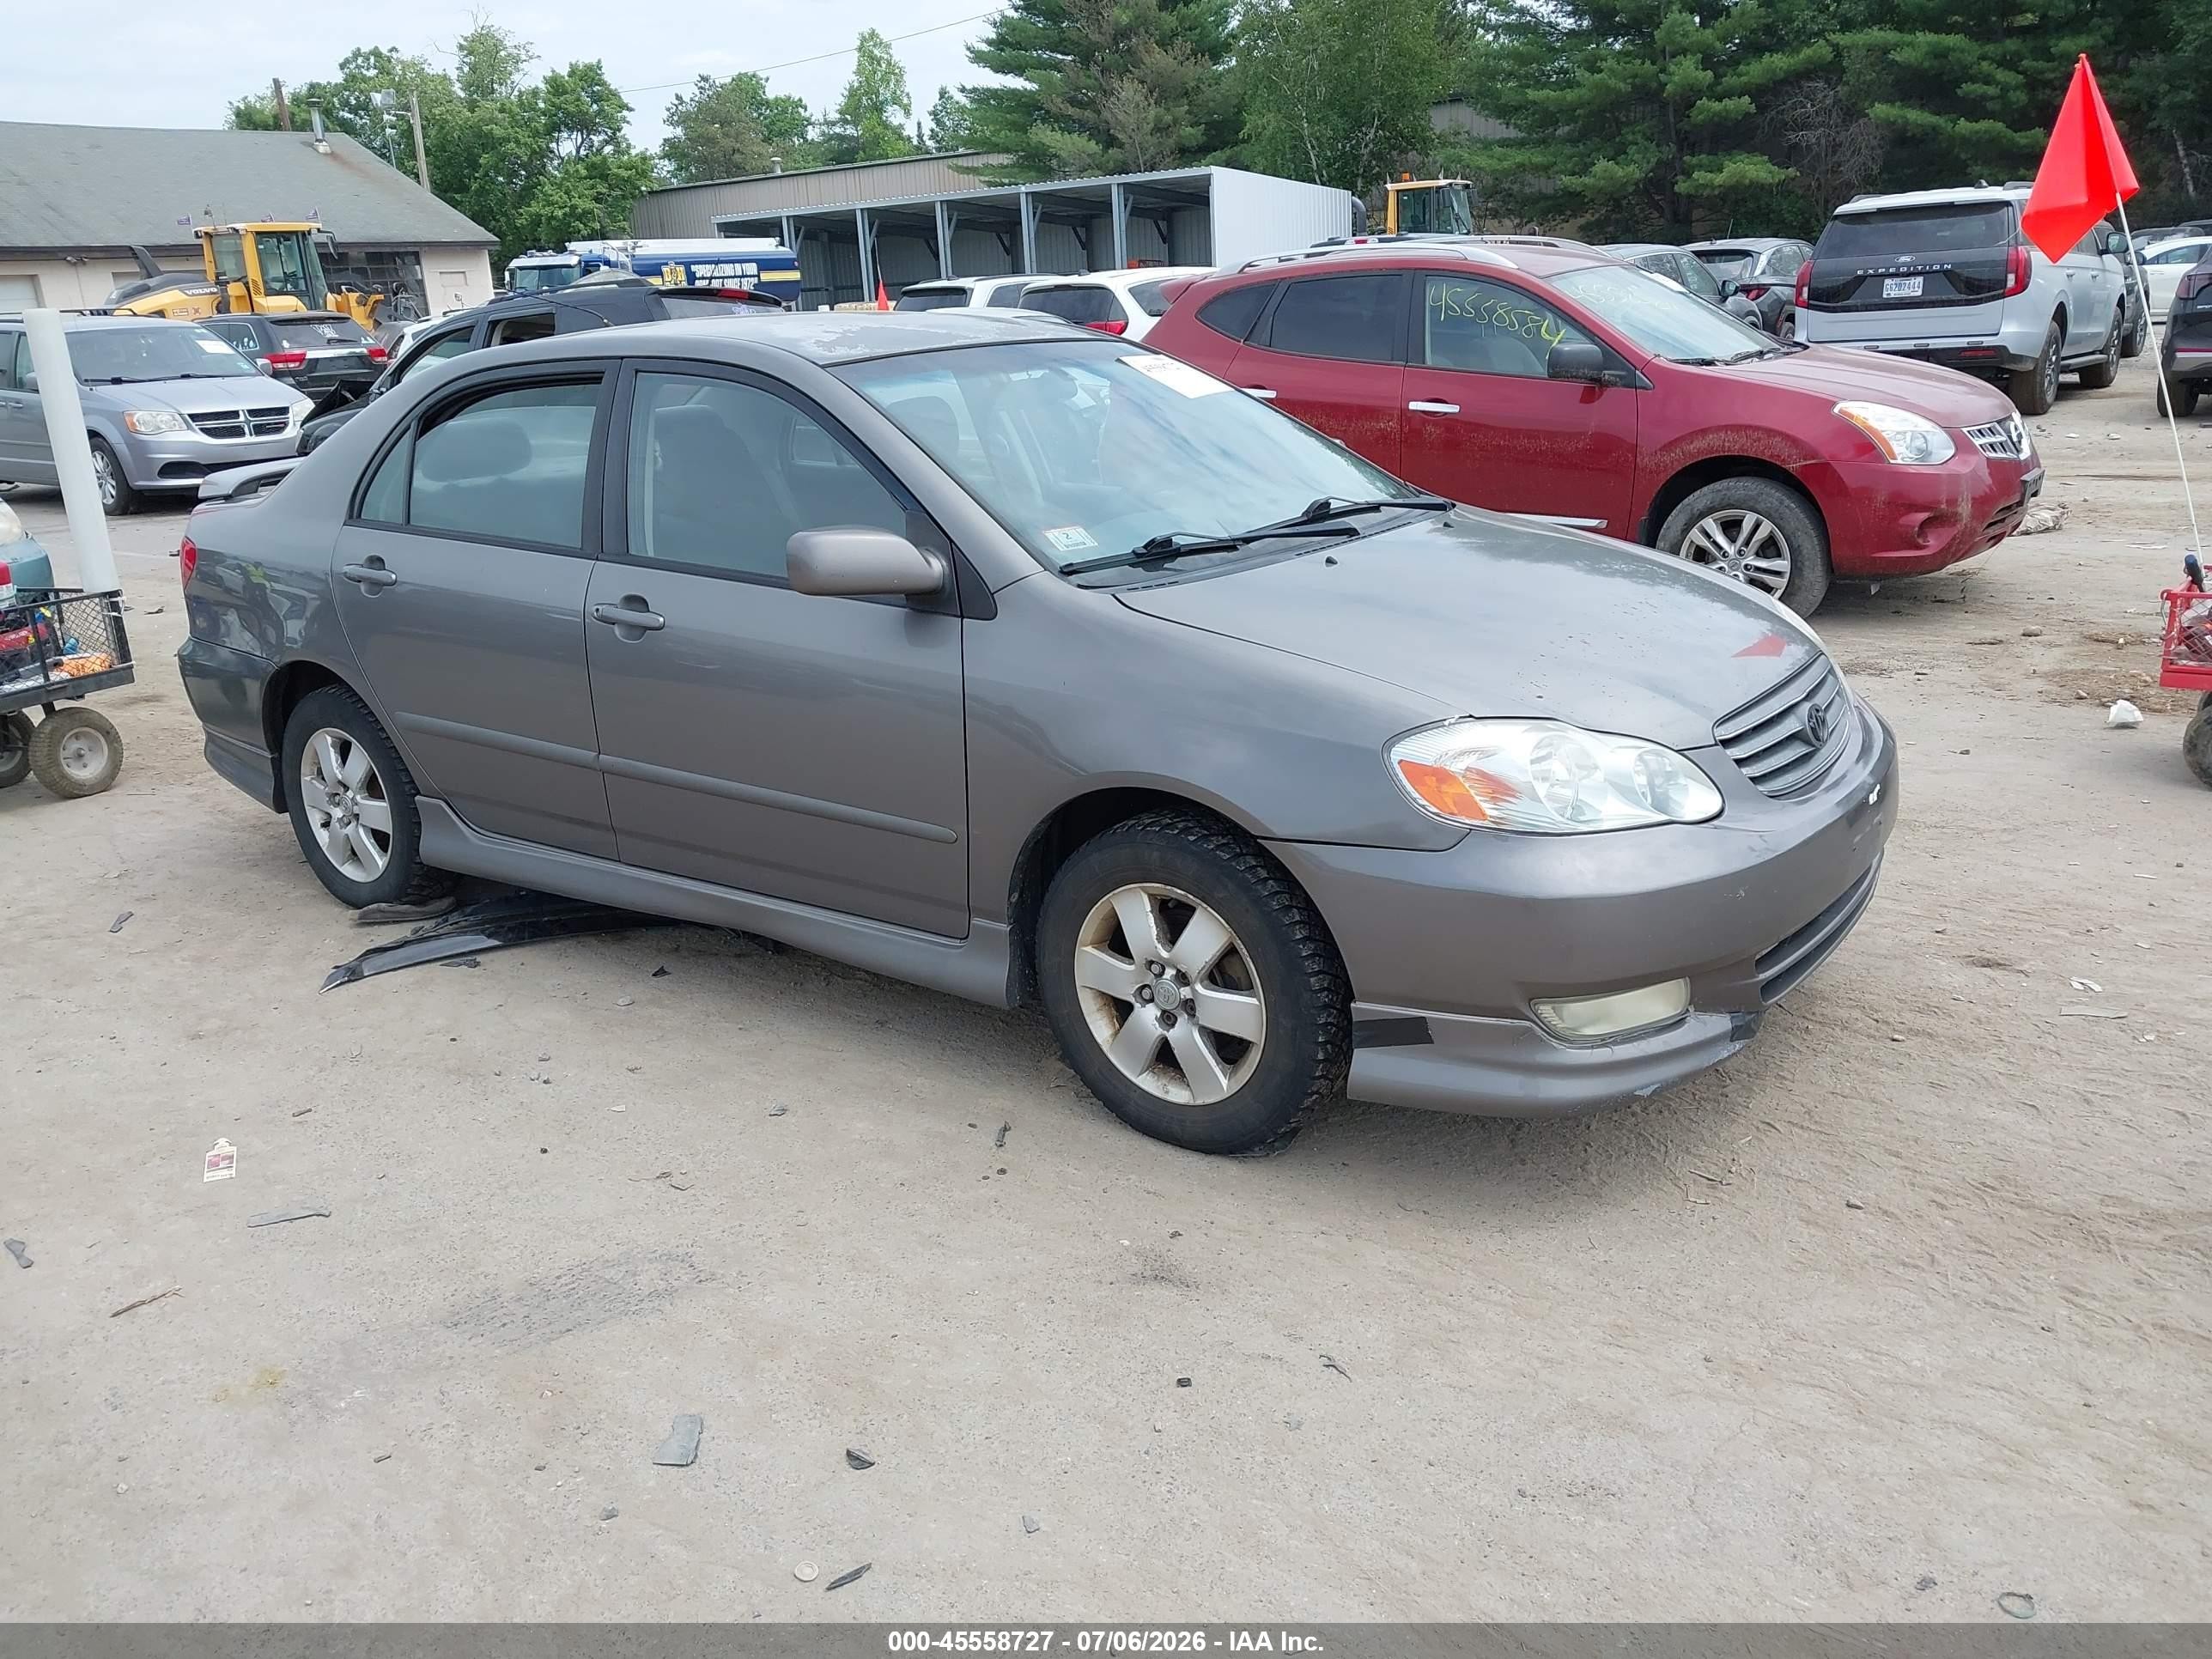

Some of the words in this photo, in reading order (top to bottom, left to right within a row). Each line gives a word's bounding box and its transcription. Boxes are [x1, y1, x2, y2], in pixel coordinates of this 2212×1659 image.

[742, 263, 757, 276] YOUR
[1856, 264, 1952, 274] EXPEDITION
[1429, 283, 1566, 360] 45558584
